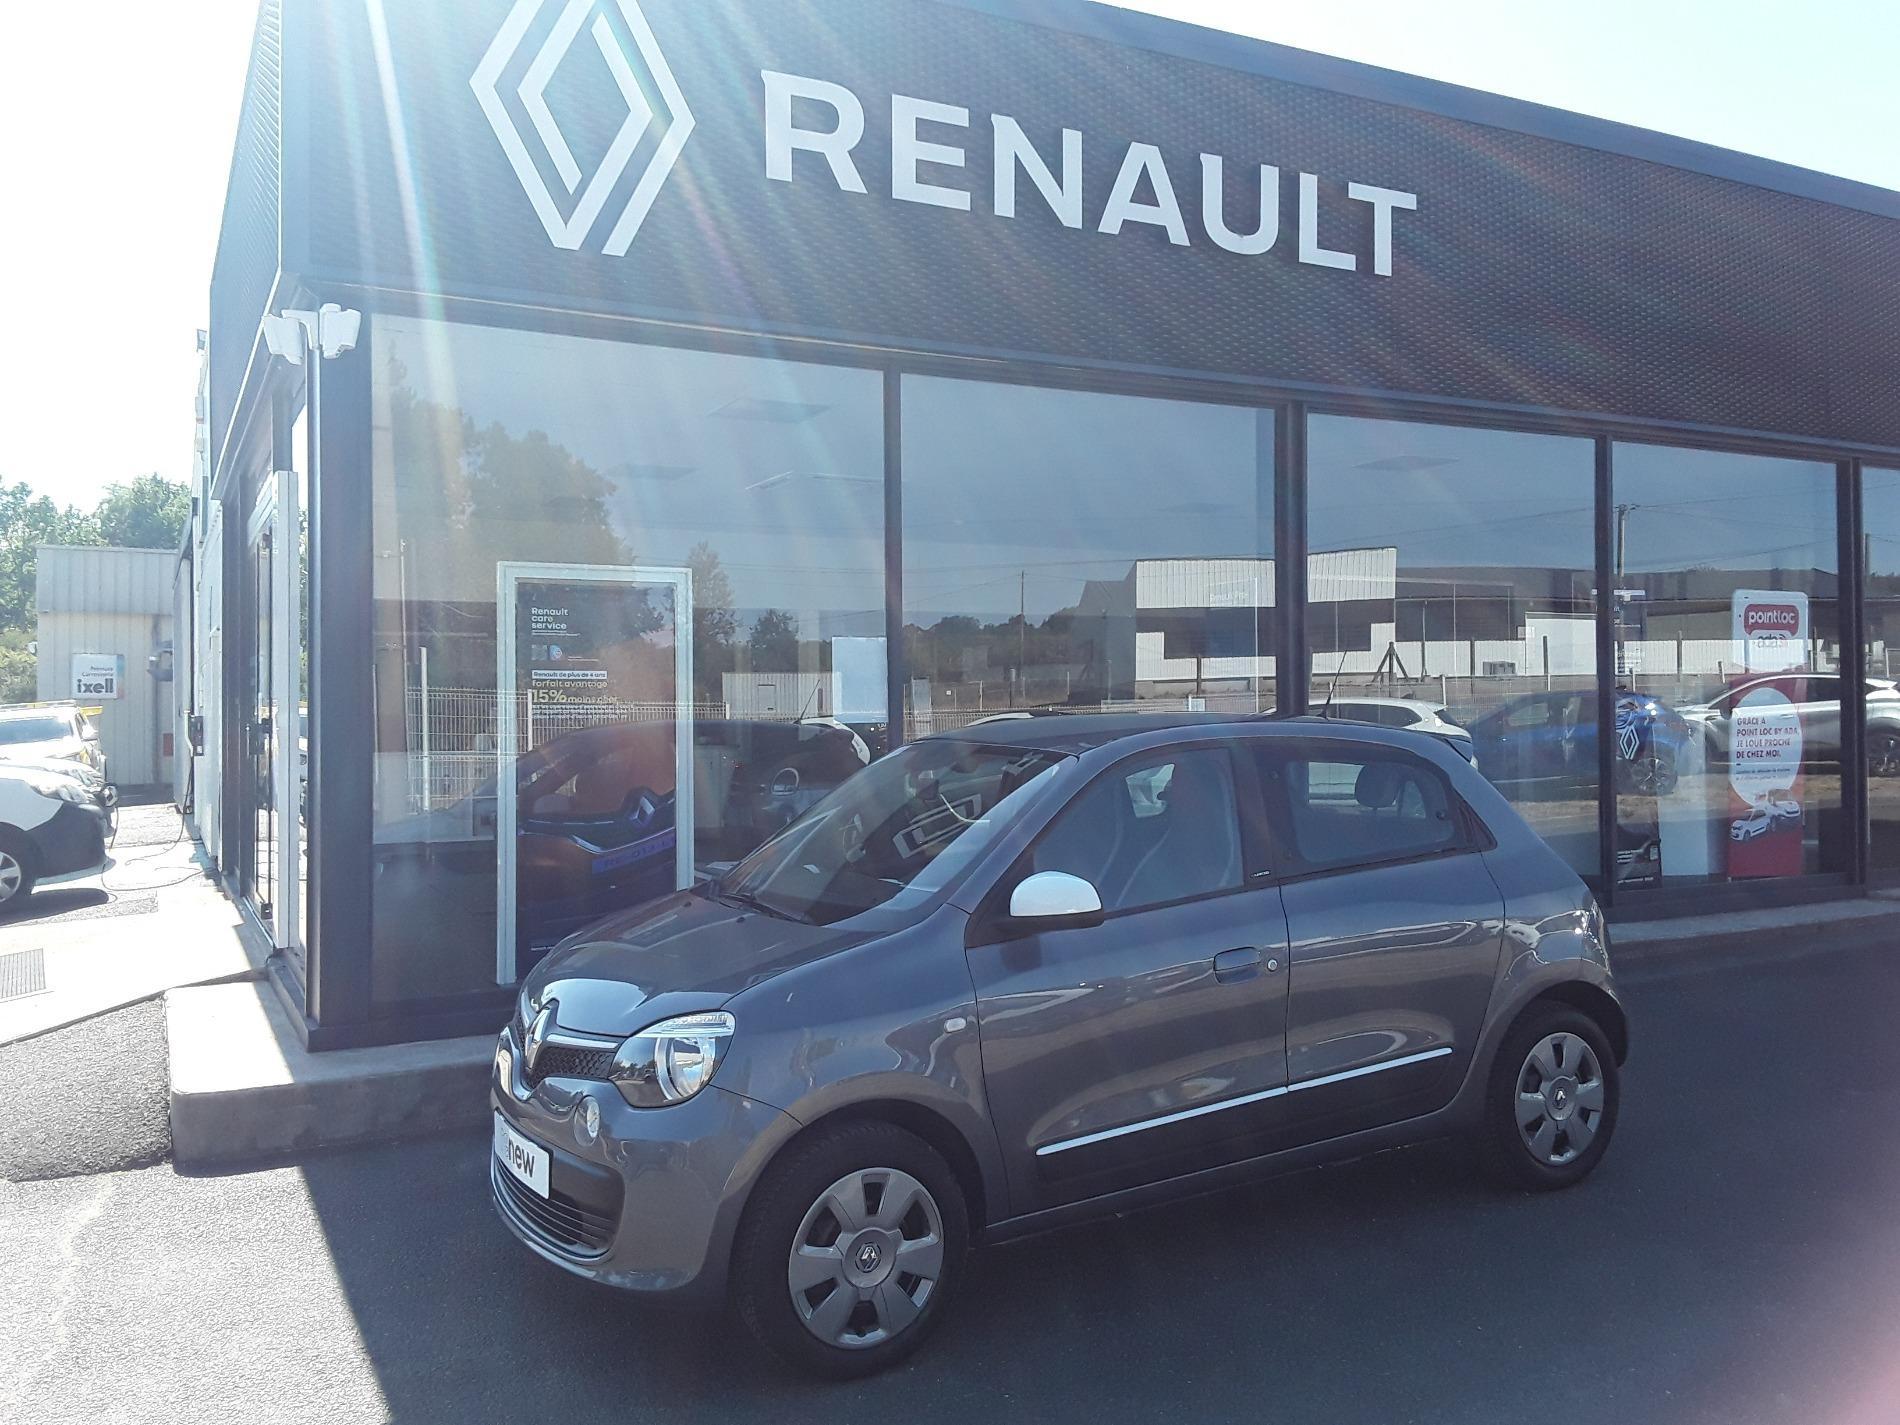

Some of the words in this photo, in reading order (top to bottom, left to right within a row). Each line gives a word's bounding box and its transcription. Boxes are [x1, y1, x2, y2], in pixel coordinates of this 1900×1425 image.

[760, 68, 1418, 277] RENAULT
[531, 607, 569, 616] Renault
[531, 615, 554, 623] care
[531, 622, 567, 630] service
[77, 678, 114, 694] ixell
[532, 679, 562, 687] forfait
[564, 680, 609, 689] avantage
[532, 689, 567, 703] 15%
[567, 695, 595, 703] moins
[1736, 728, 1759, 737] POINT
[1760, 727, 1773, 736] LOC
[1736, 740, 1744, 748] JE
[1736, 750, 1745, 759] DE
[1746, 750, 1765, 758] CHEZ
[508, 1137, 535, 1178] new
